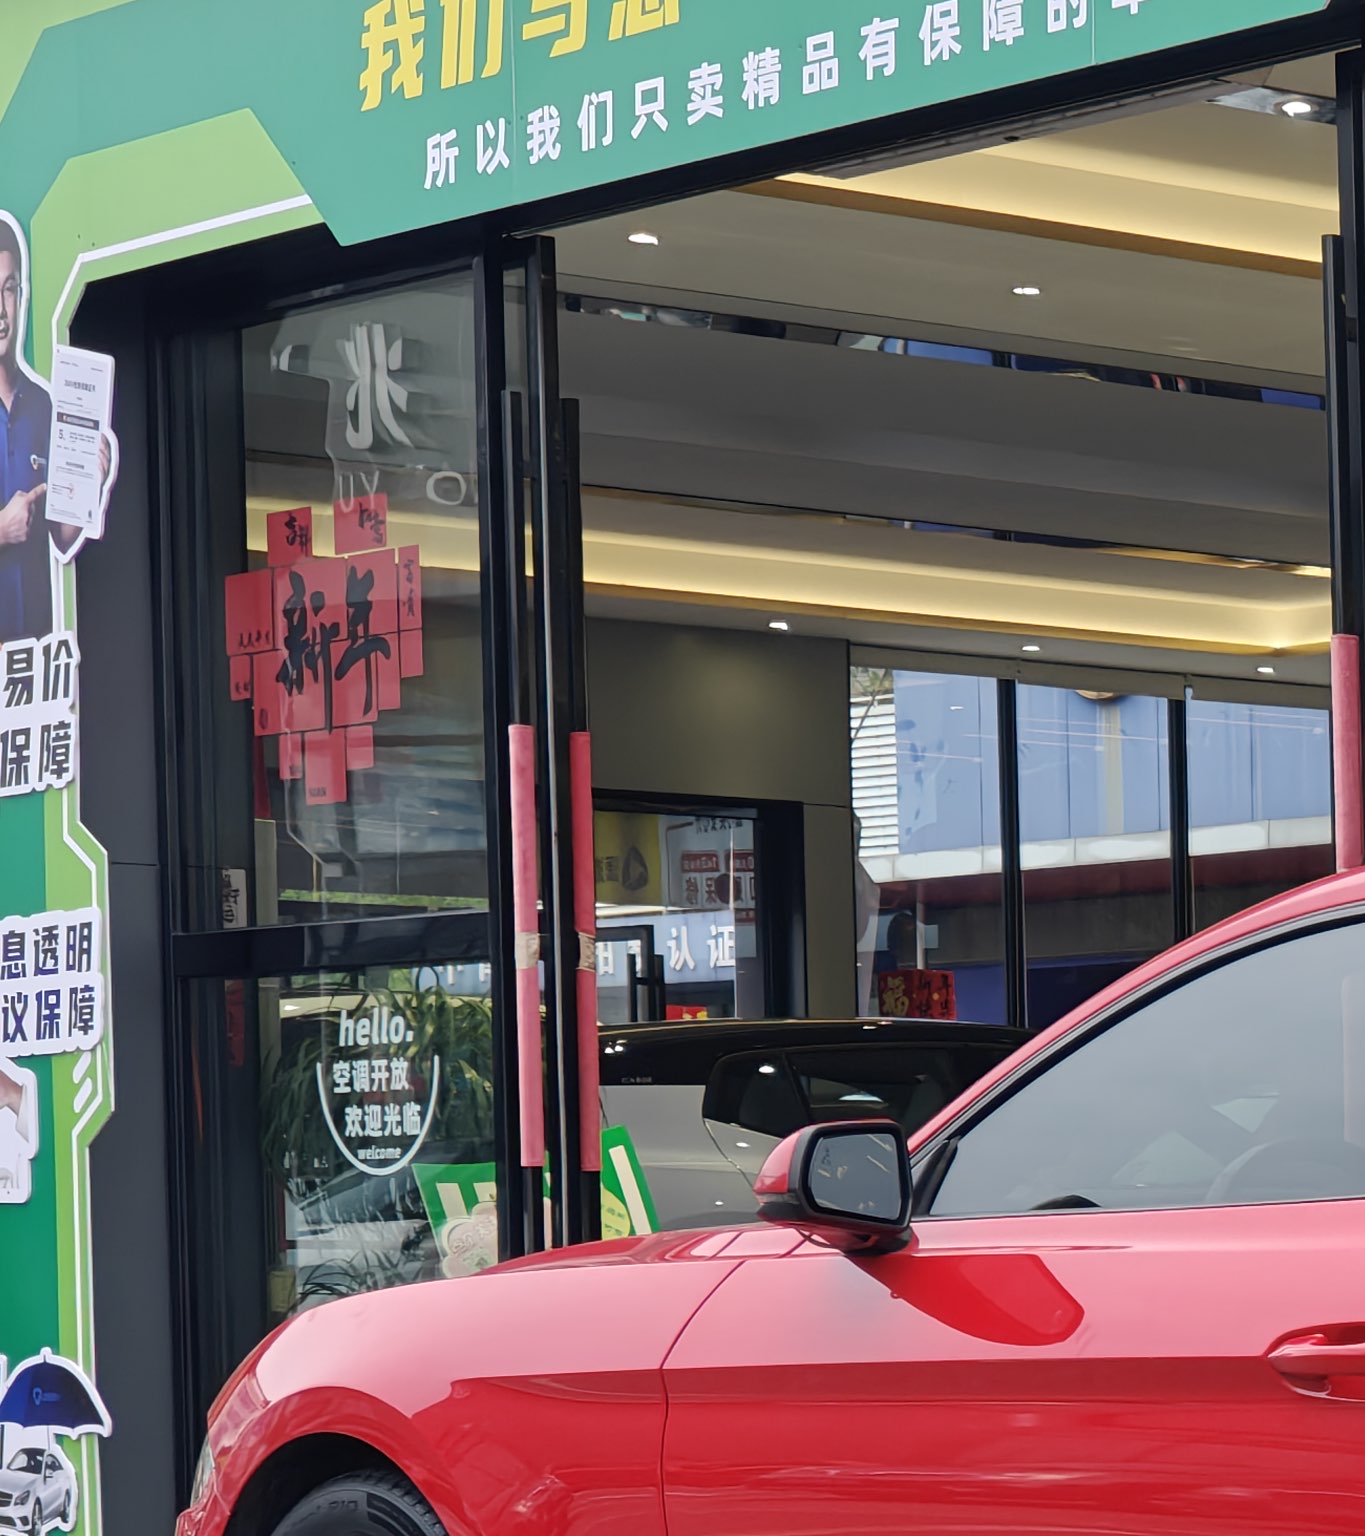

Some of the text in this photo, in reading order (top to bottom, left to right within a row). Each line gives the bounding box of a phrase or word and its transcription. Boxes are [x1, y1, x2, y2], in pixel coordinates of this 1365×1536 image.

[423, 0, 1146, 190] 所以我们只卖精品有保障的
[4, 637, 74, 709] 易价
[276, 566, 391, 734] 新年
[0, 720, 73, 789] 保障
[0, 921, 93, 981] 息透明
[1, 984, 96, 1043] 议保障
[339, 1005, 414, 1047] hello.
[332, 1056, 410, 1094] 空调开放
[344, 1101, 422, 1138] 欢迎光临
[356, 1145, 402, 1161] welcome
